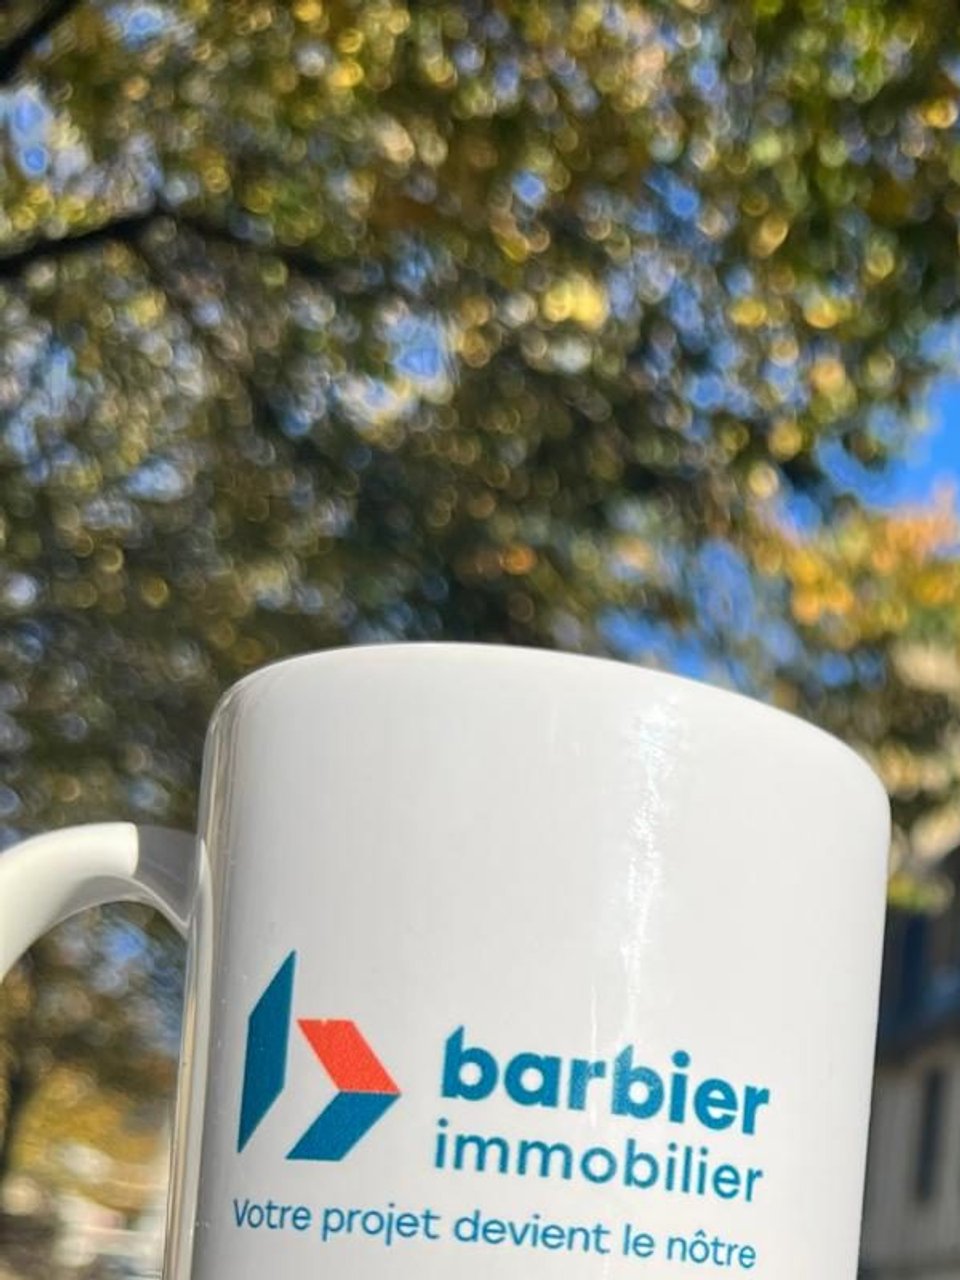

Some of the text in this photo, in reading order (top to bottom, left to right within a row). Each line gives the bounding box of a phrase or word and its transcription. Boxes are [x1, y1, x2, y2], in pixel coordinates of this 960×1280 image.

[440, 1024, 771, 1137] barbier
[434, 1118, 764, 1203] immobilier
[233, 1198, 757, 1270] Votre projet devient le nôtre
